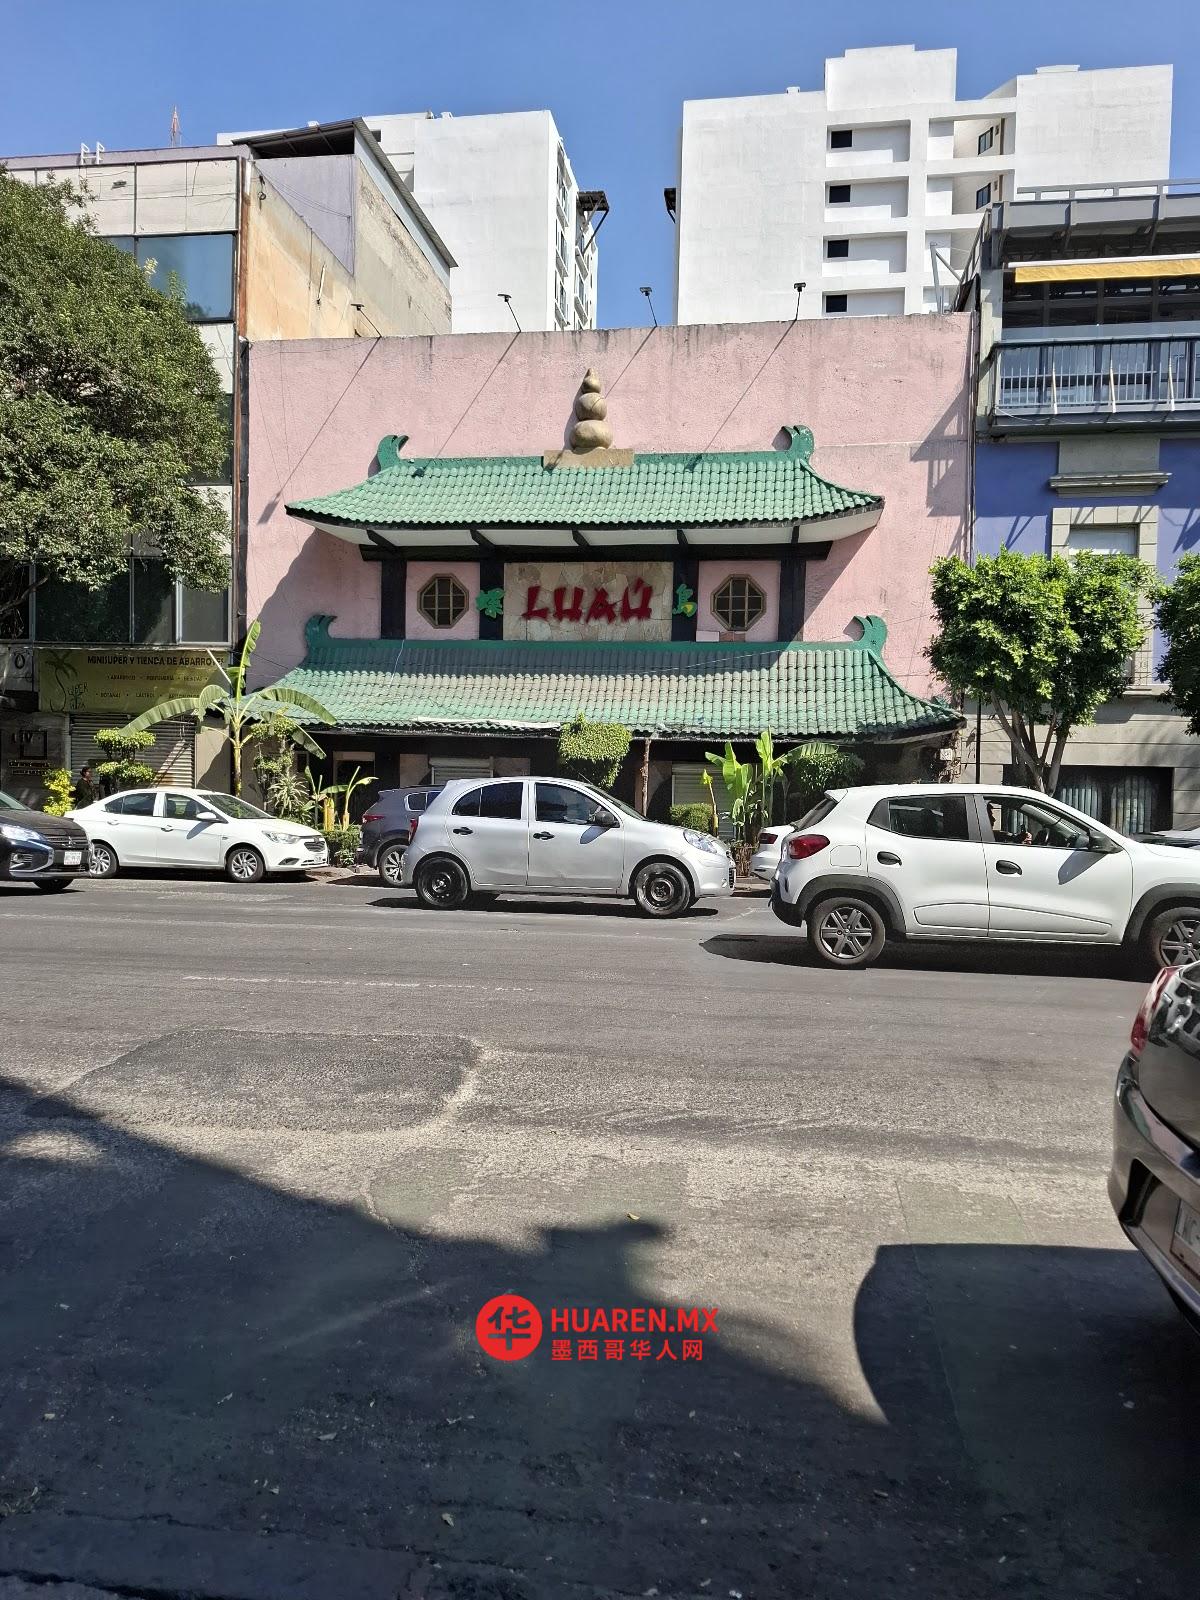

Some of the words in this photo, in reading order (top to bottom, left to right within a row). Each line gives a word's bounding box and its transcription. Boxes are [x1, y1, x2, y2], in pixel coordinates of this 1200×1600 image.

[521, 577, 654, 624] LUAÚ
[87, 655, 128, 665] MINISUPER
[129, 656, 135, 665] Y
[137, 656, 166, 666] TIENDA
[166, 656, 178, 666] DE
